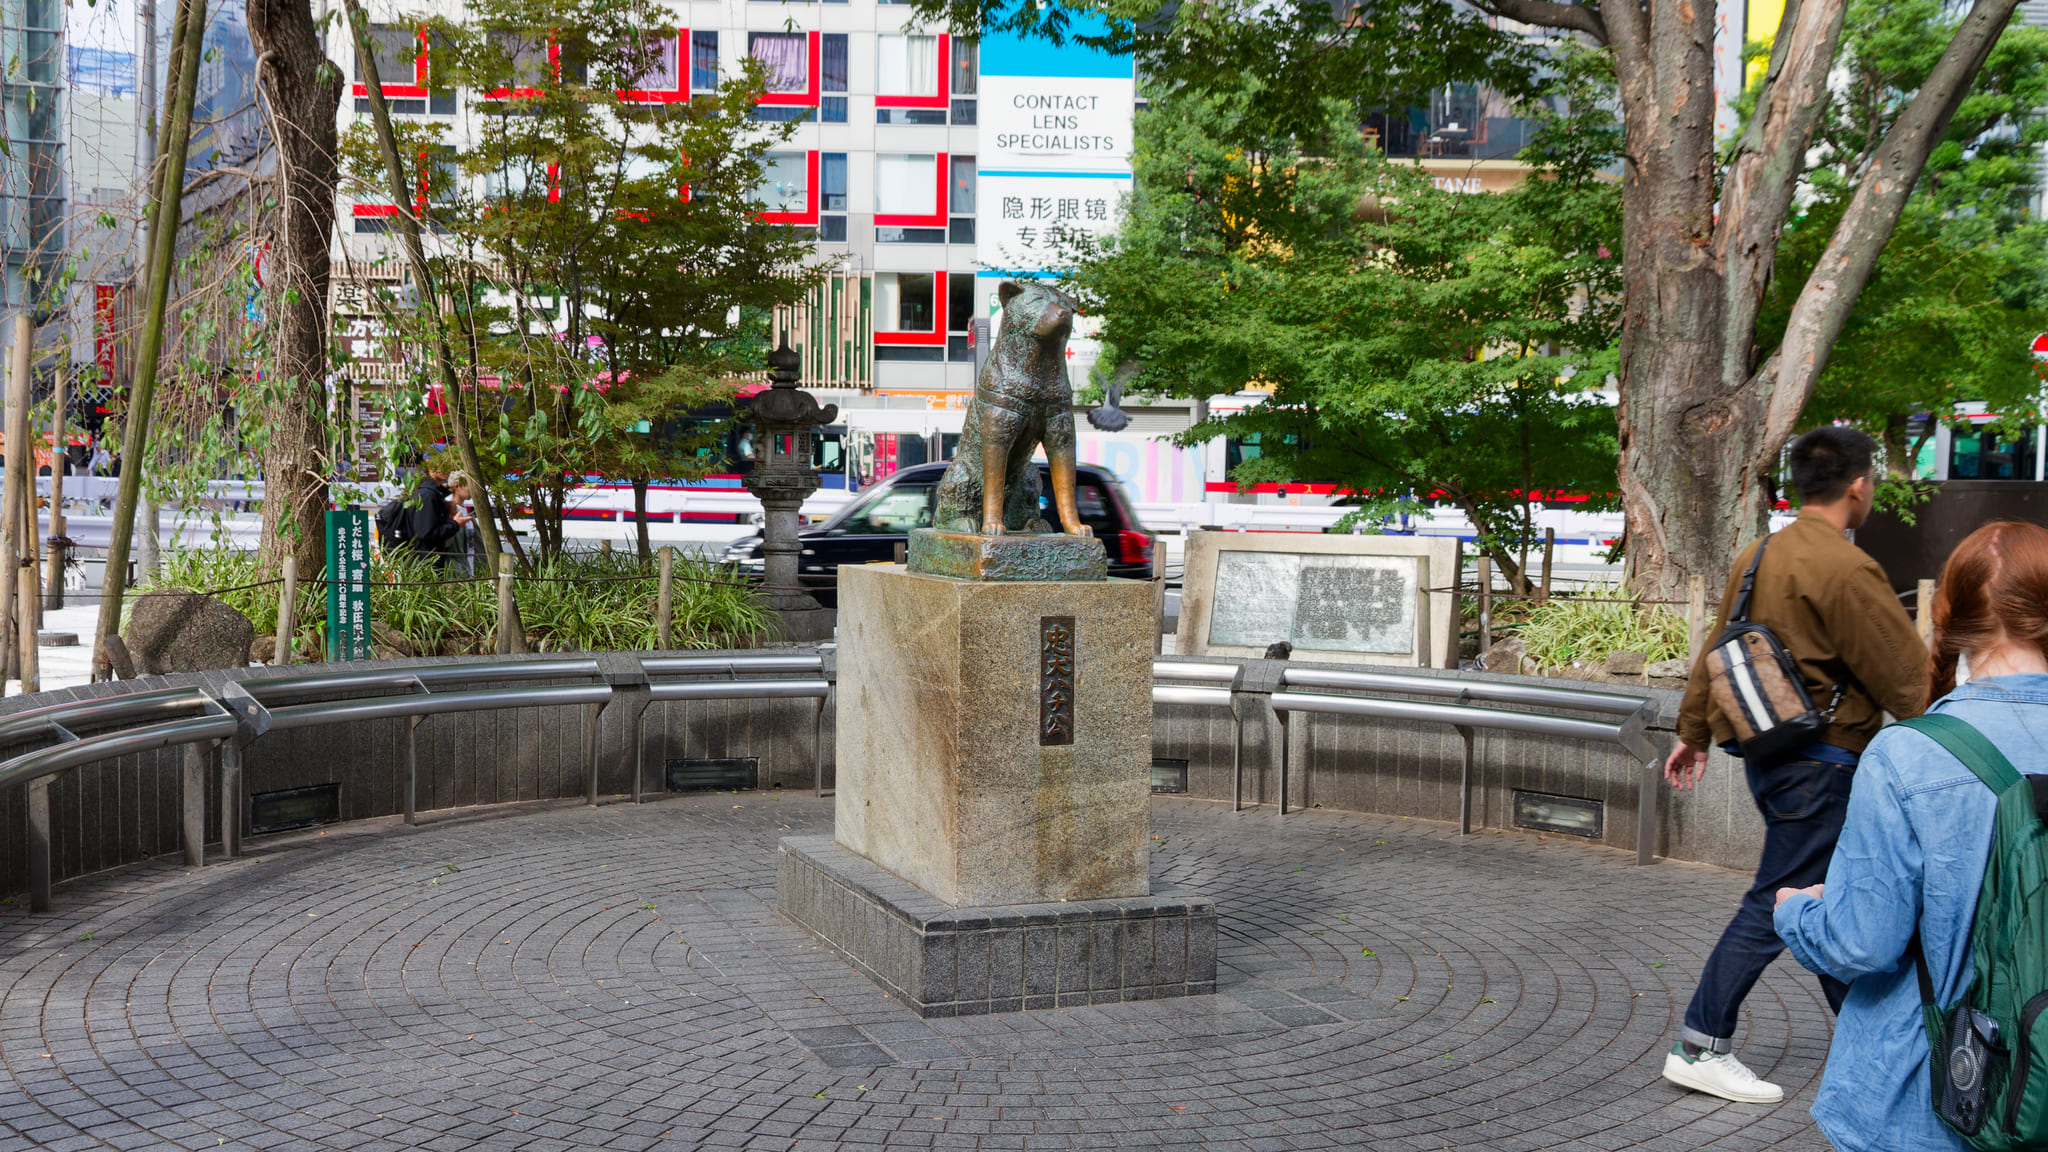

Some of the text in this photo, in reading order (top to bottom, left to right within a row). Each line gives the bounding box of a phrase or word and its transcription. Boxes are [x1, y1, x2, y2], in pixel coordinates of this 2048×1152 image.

[1013, 94, 1099, 111] CONTACT
[1033, 115, 1078, 130] LENS
[997, 134, 1114, 150] SPECIALISTS
[1002, 196, 1108, 221] 隐形眼镜
[351, 514, 364, 561] しだれ桜
[1044, 623, 1071, 736] 忠犬ハチ公
